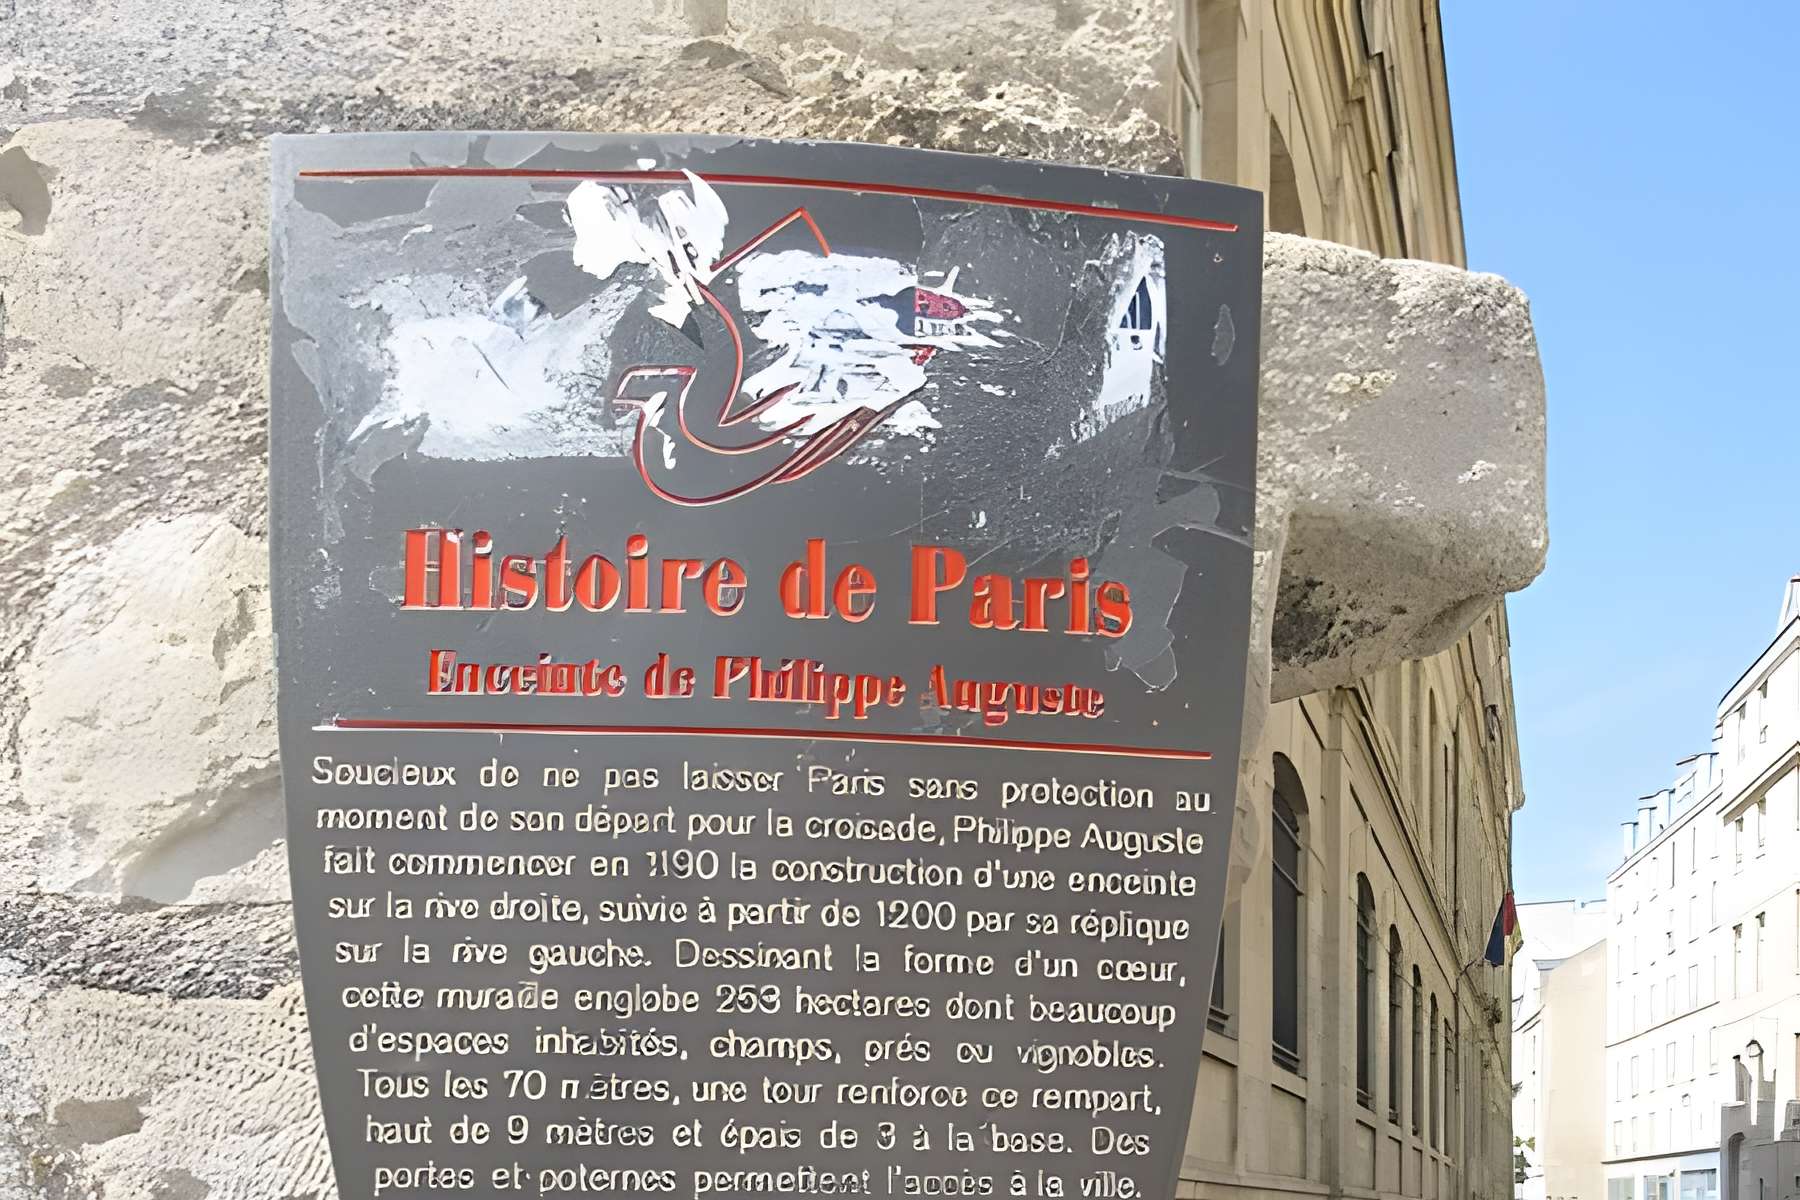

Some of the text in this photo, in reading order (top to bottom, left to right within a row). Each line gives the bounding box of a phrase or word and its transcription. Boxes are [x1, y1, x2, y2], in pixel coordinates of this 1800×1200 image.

[399, 525, 1135, 638] Histoire de Paris
[427, 647, 1105, 727] Enceinte de Philippe Auguste
[312, 756, 1210, 811] Soucieux de ne pas laisser Paris sans protection au
[316, 804, 1203, 858] moment de son départ pour la croisade, Philippe Auguste
[324, 846, 1196, 896] fait commencer en 1190 la construction d'une enceinte
[328, 891, 1189, 945] sur la rive droite, suivie à partir de 1200 par sa réplique
[335, 936, 1186, 987] sur la rive gauche. Dessinant la forme d'un cœur,
[342, 981, 423, 1008] cette
[574, 984, 699, 1018] englobe
[796, 987, 930, 1017] hectares
[946, 994, 1014, 1020] dont
[1030, 994, 1176, 1031] beaucoup
[349, 1024, 509, 1061] d'espaces
[710, 1028, 841, 1064] champs,
[865, 1033, 930, 1067] prés
[957, 1042, 992, 1064] ou
[1018, 1039, 1164, 1073] vignobles.
[358, 1068, 429, 1098] Tous
[444, 1070, 488, 1098] les
[503, 1070, 546, 1100] 70
[692, 1082, 746, 1102] une
[763, 1077, 822, 1103] tour
[838, 1077, 967, 1107] renforce
[982, 1087, 1018, 1107] ce
[1033, 1084, 1161, 1117] rempart,
[365, 1115, 1149, 1156] haut de 9 mètres et épais de 3 à la base. Des
[374, 1160, 474, 1196] portes
[491, 1162, 522, 1188] et
[539, 1163, 676, 1197] poternes
[887, 1166, 992, 1196] l'accès
[1010, 1171, 1026, 1197] à
[1037, 1170, 1064, 1197] la
[1081, 1171, 1141, 1199] ville.
